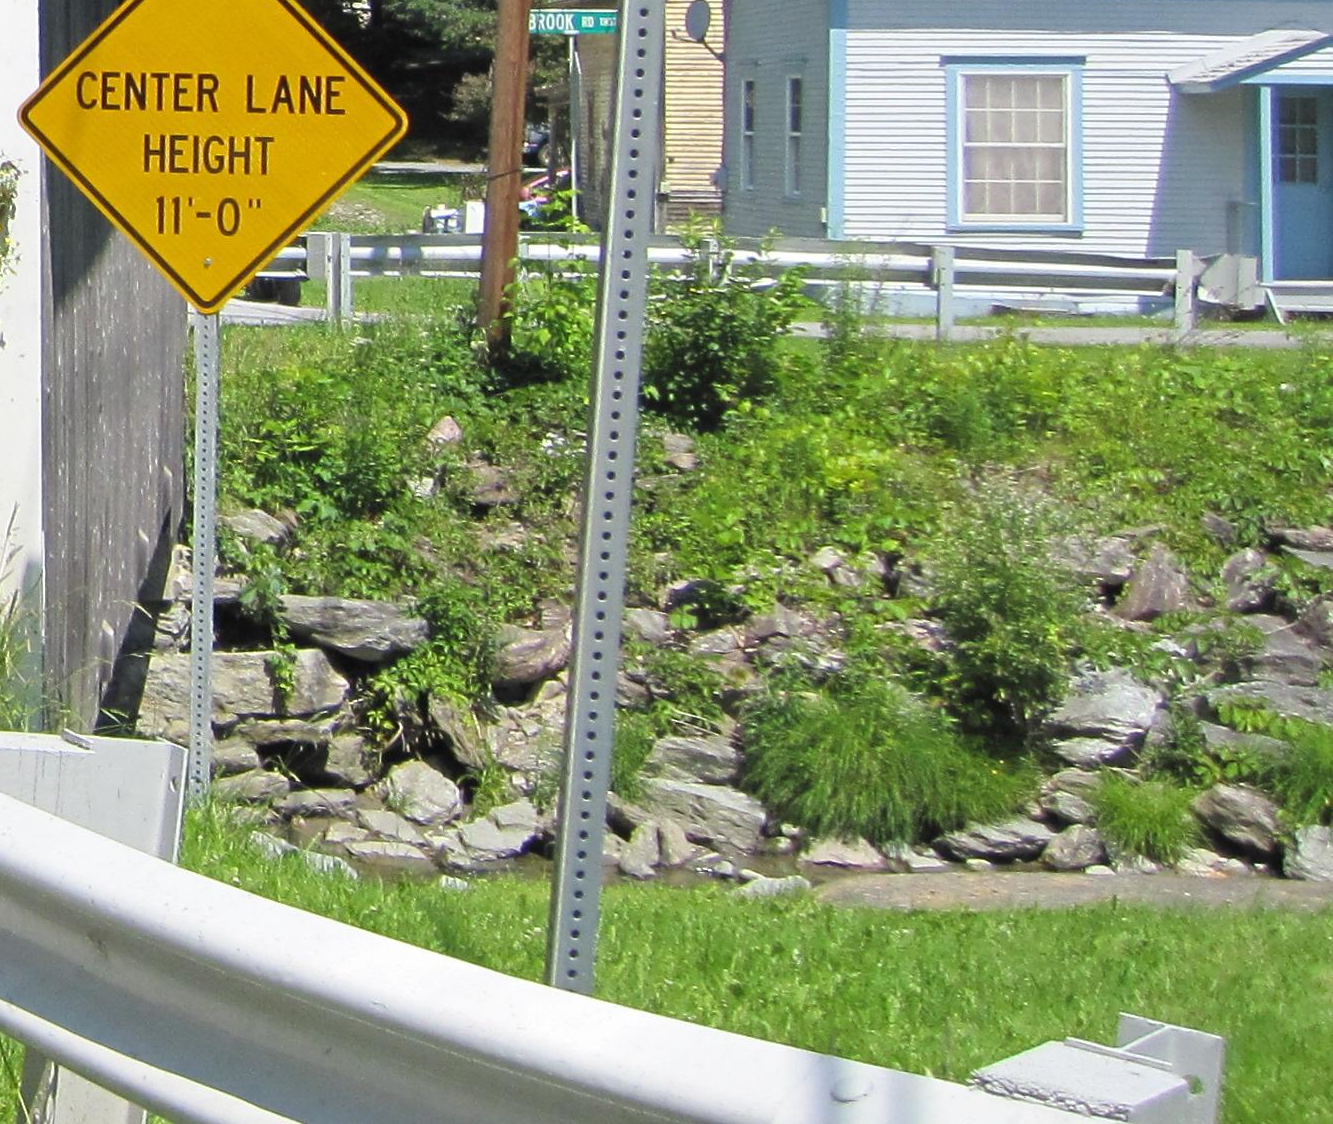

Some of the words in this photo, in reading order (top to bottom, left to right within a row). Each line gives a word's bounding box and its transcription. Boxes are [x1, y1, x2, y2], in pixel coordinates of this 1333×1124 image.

[528, 13, 575, 30] BROOK
[581, 16, 594, 28] RD
[76, 71, 219, 112] CENTER
[246, 75, 346, 115] LANE
[144, 134, 274, 175] HEIGHT
[156, 196, 261, 237] 11'-0"
